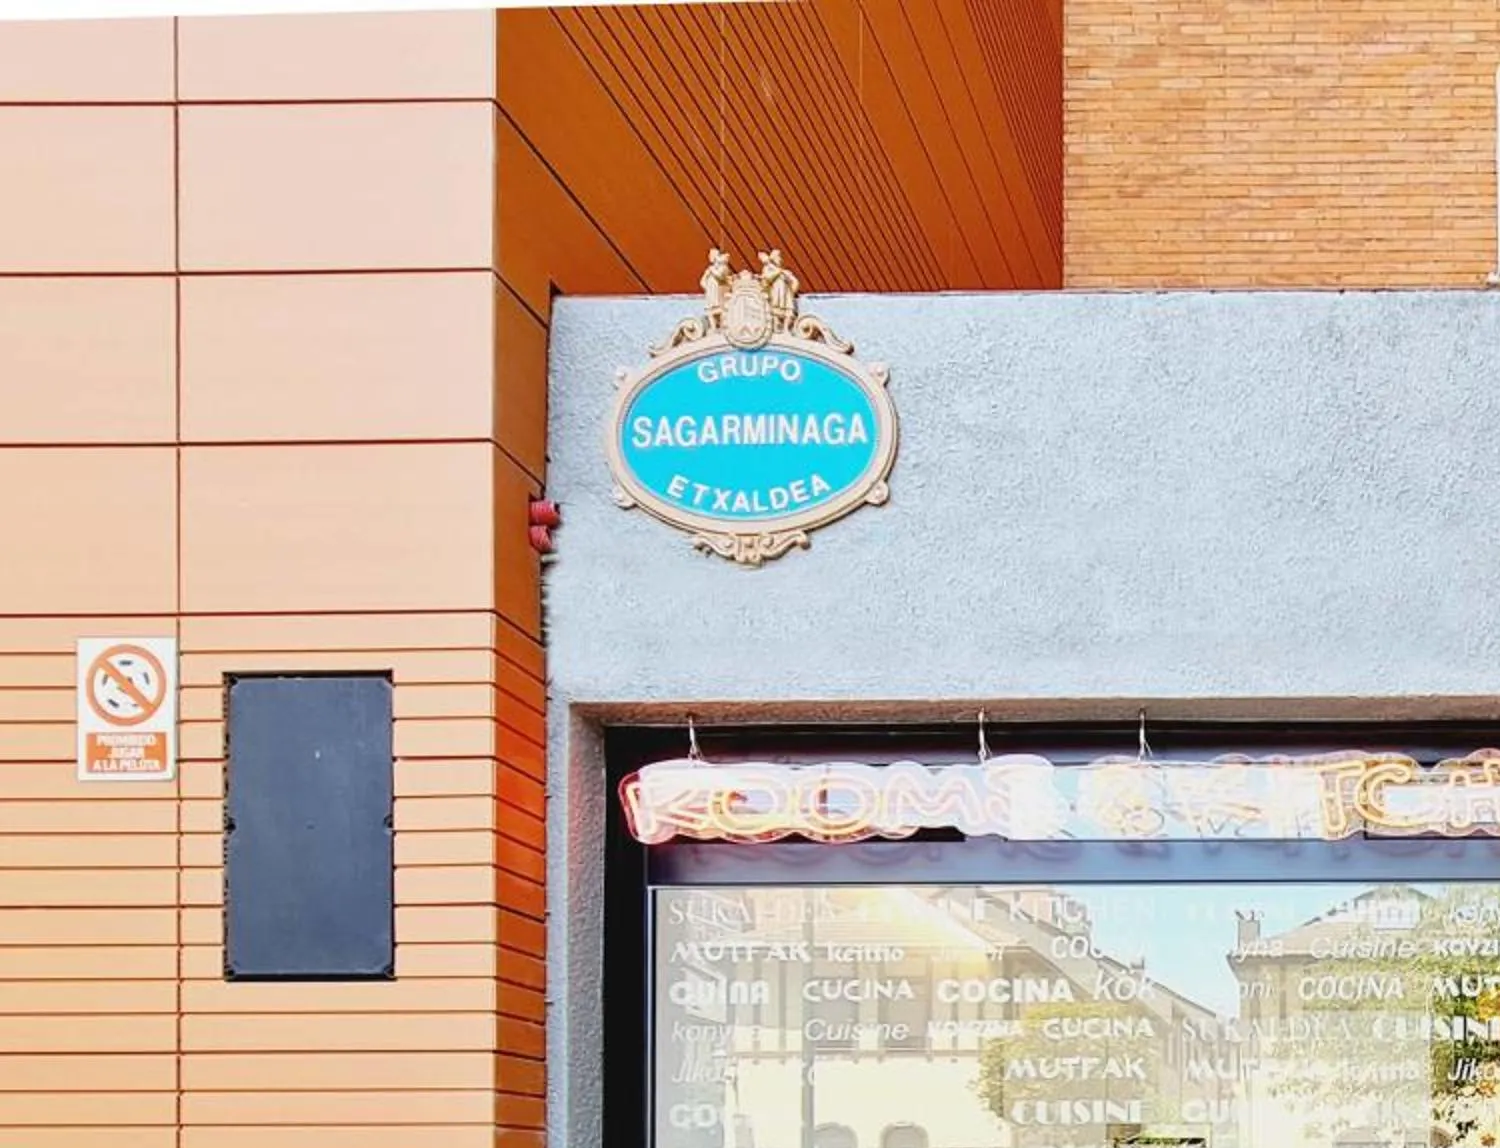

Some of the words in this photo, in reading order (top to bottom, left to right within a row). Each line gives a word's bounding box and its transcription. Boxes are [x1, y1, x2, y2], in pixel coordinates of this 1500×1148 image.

[698, 354, 802, 383] GRUPO
[632, 413, 868, 449] SAGARMINAGA
[667, 473, 832, 512] ETXALDEA
[802, 979, 914, 1001] CUCINA
[936, 978, 1075, 1003] COCINA
[1299, 975, 1403, 1001] COCINA
[804, 1018, 911, 1042] Cuisine
[1044, 1018, 1155, 1040] CUCINA
[1005, 1056, 1146, 1081] MUTFAK
